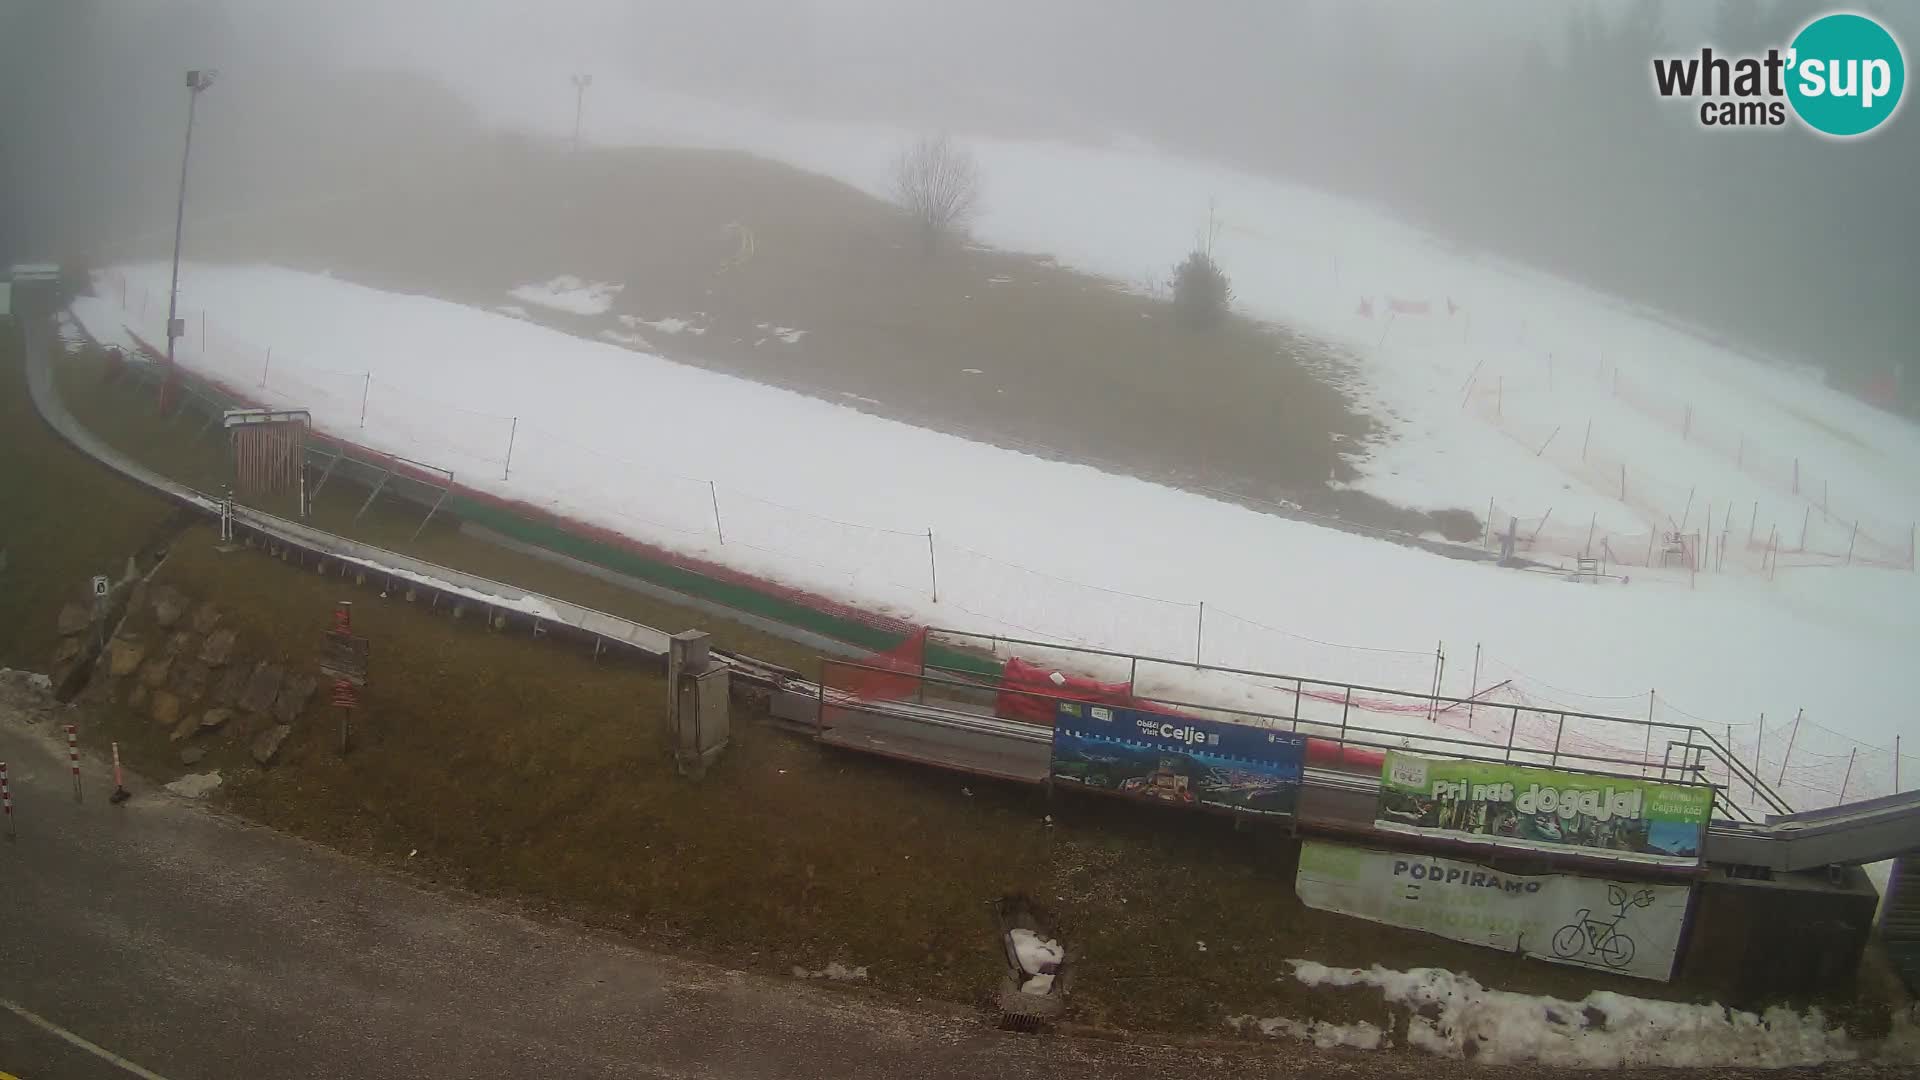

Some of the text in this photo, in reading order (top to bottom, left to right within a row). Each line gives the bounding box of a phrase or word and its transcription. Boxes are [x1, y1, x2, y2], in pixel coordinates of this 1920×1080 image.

[1160, 722, 1206, 745] Celje
[1431, 778, 1467, 801] Pri
[1472, 782, 1514, 802] nas
[1393, 859, 1542, 894] PODPIRAMO
